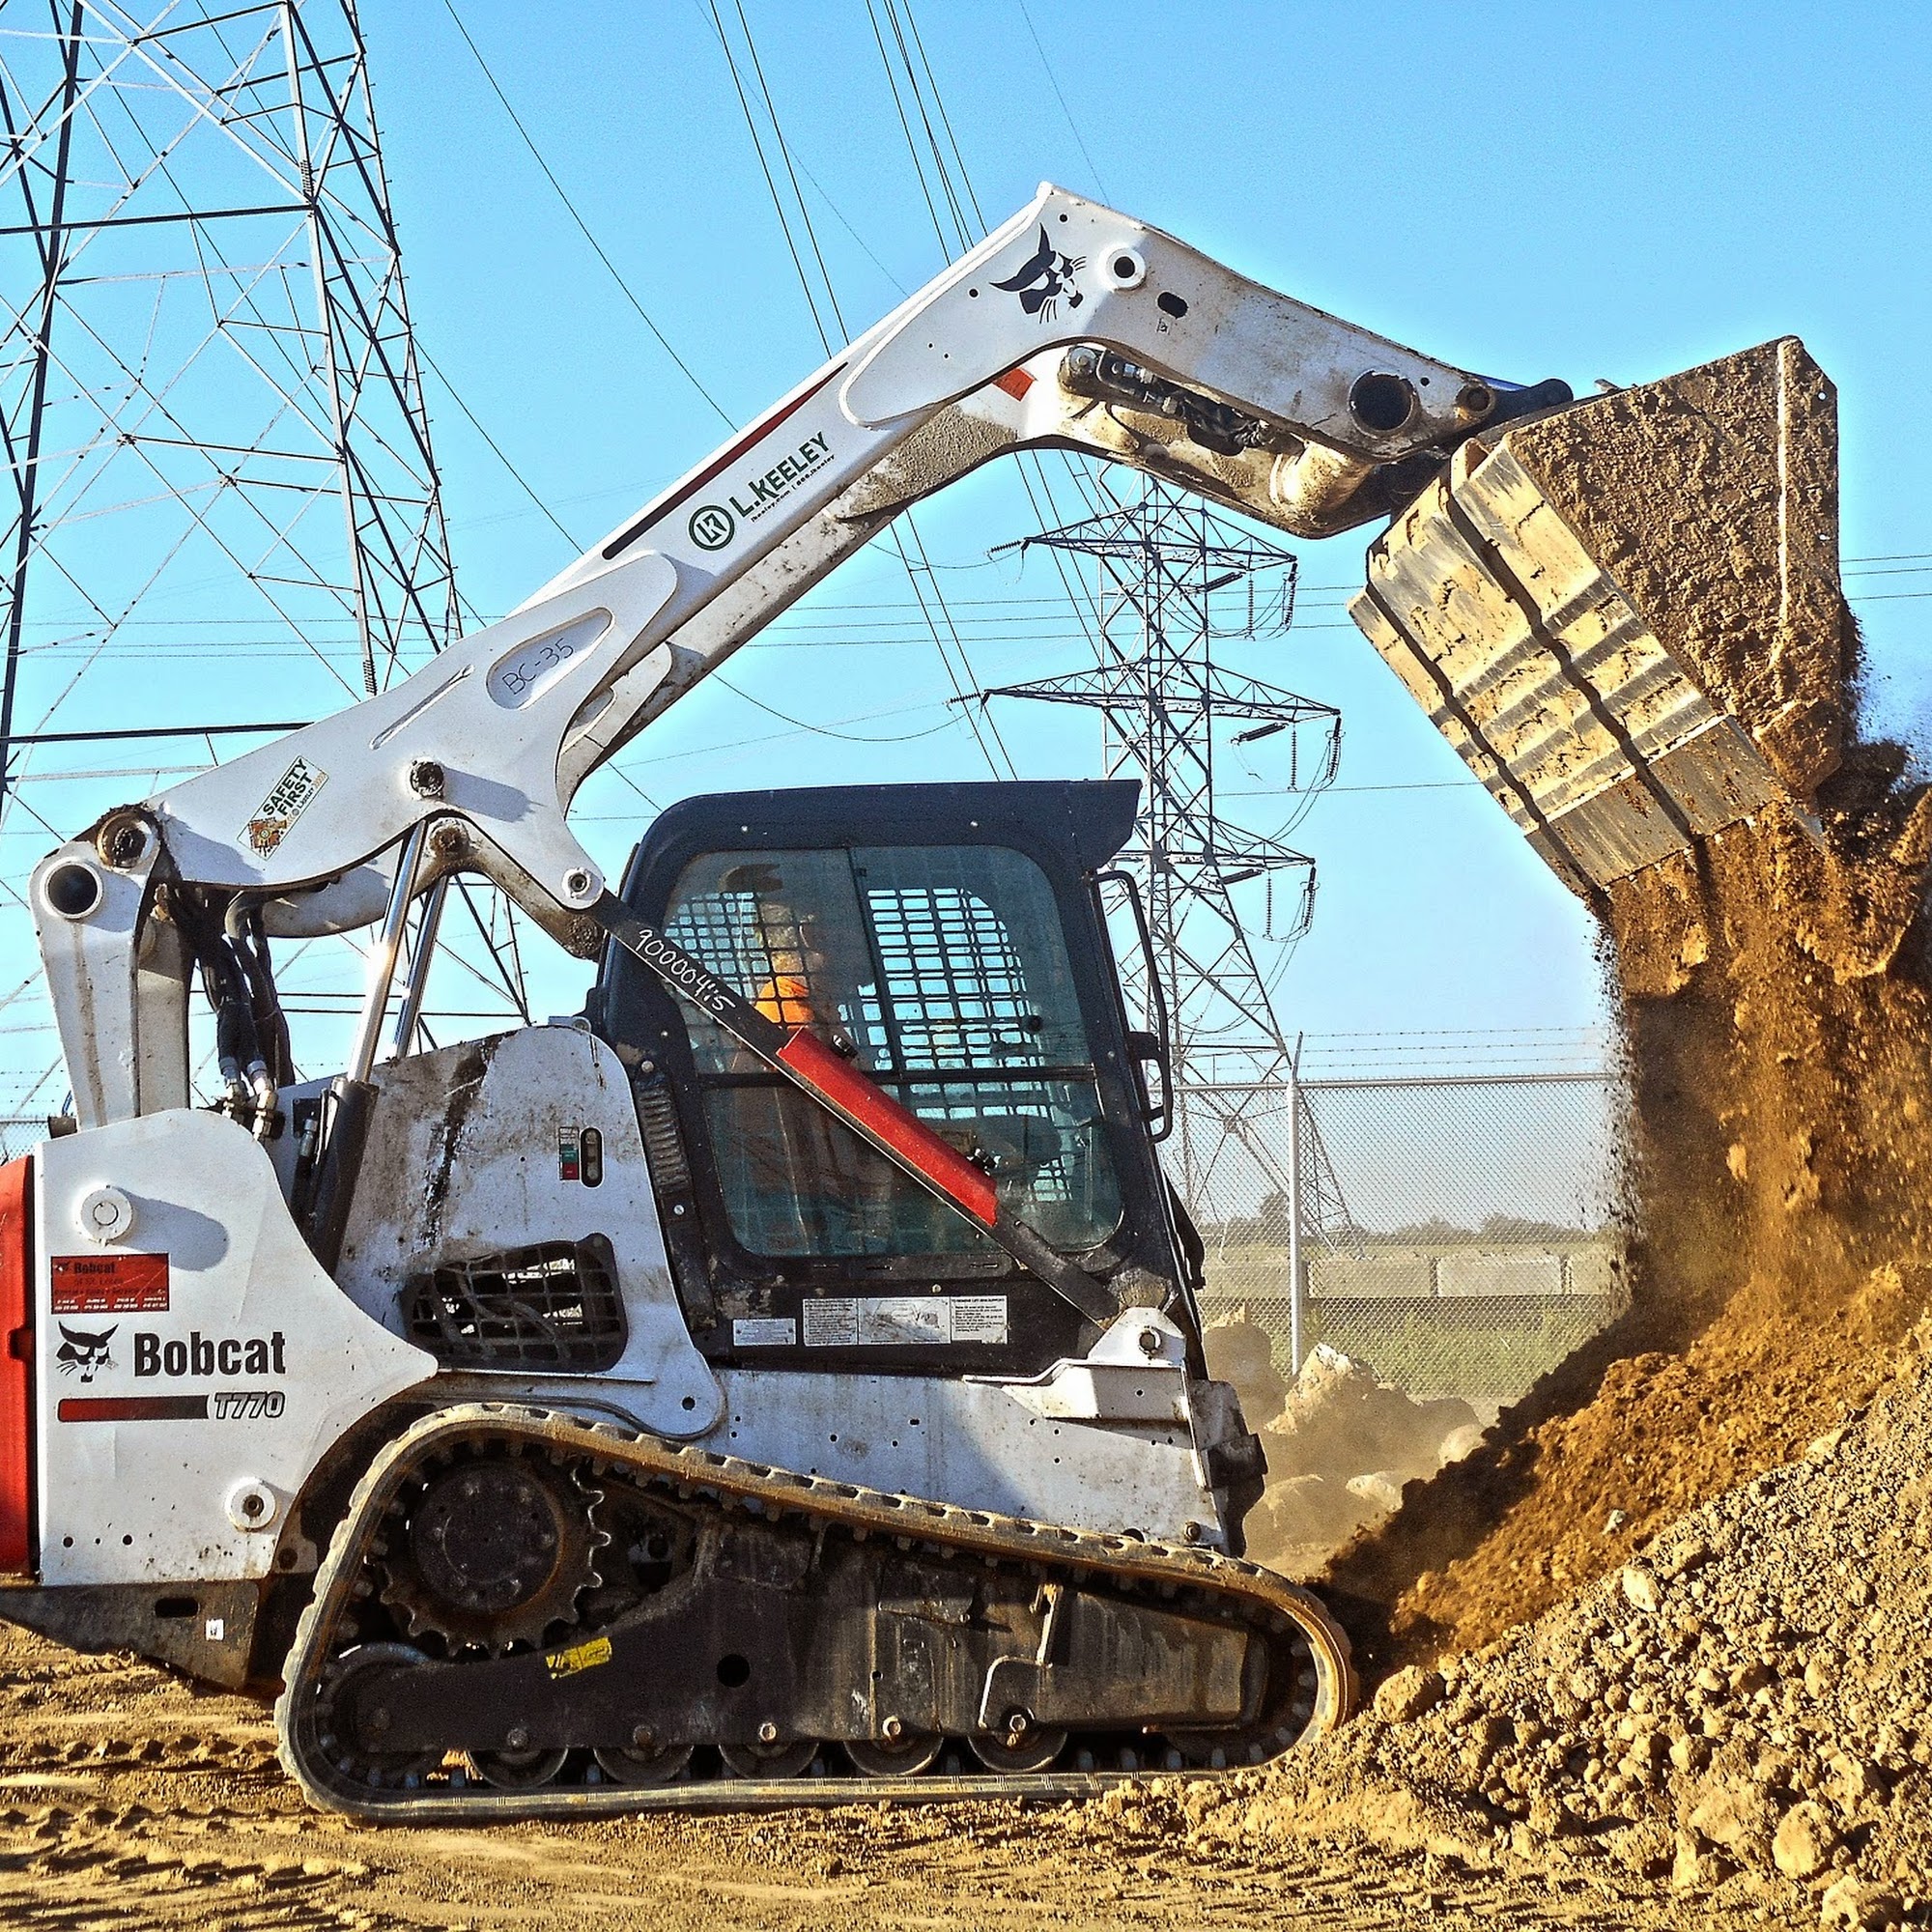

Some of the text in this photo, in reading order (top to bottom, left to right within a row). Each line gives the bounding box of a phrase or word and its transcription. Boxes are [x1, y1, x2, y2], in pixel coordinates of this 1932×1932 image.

[728, 431, 829, 518] L.KEELEY
[501, 638, 574, 695] BC-35
[263, 758, 307, 815] SAFETY
[277, 772, 312, 816] FIRST
[74, 1262, 115, 1273] Bobcat
[134, 1331, 286, 1377] Bobcat
[214, 1391, 285, 1419] T770
